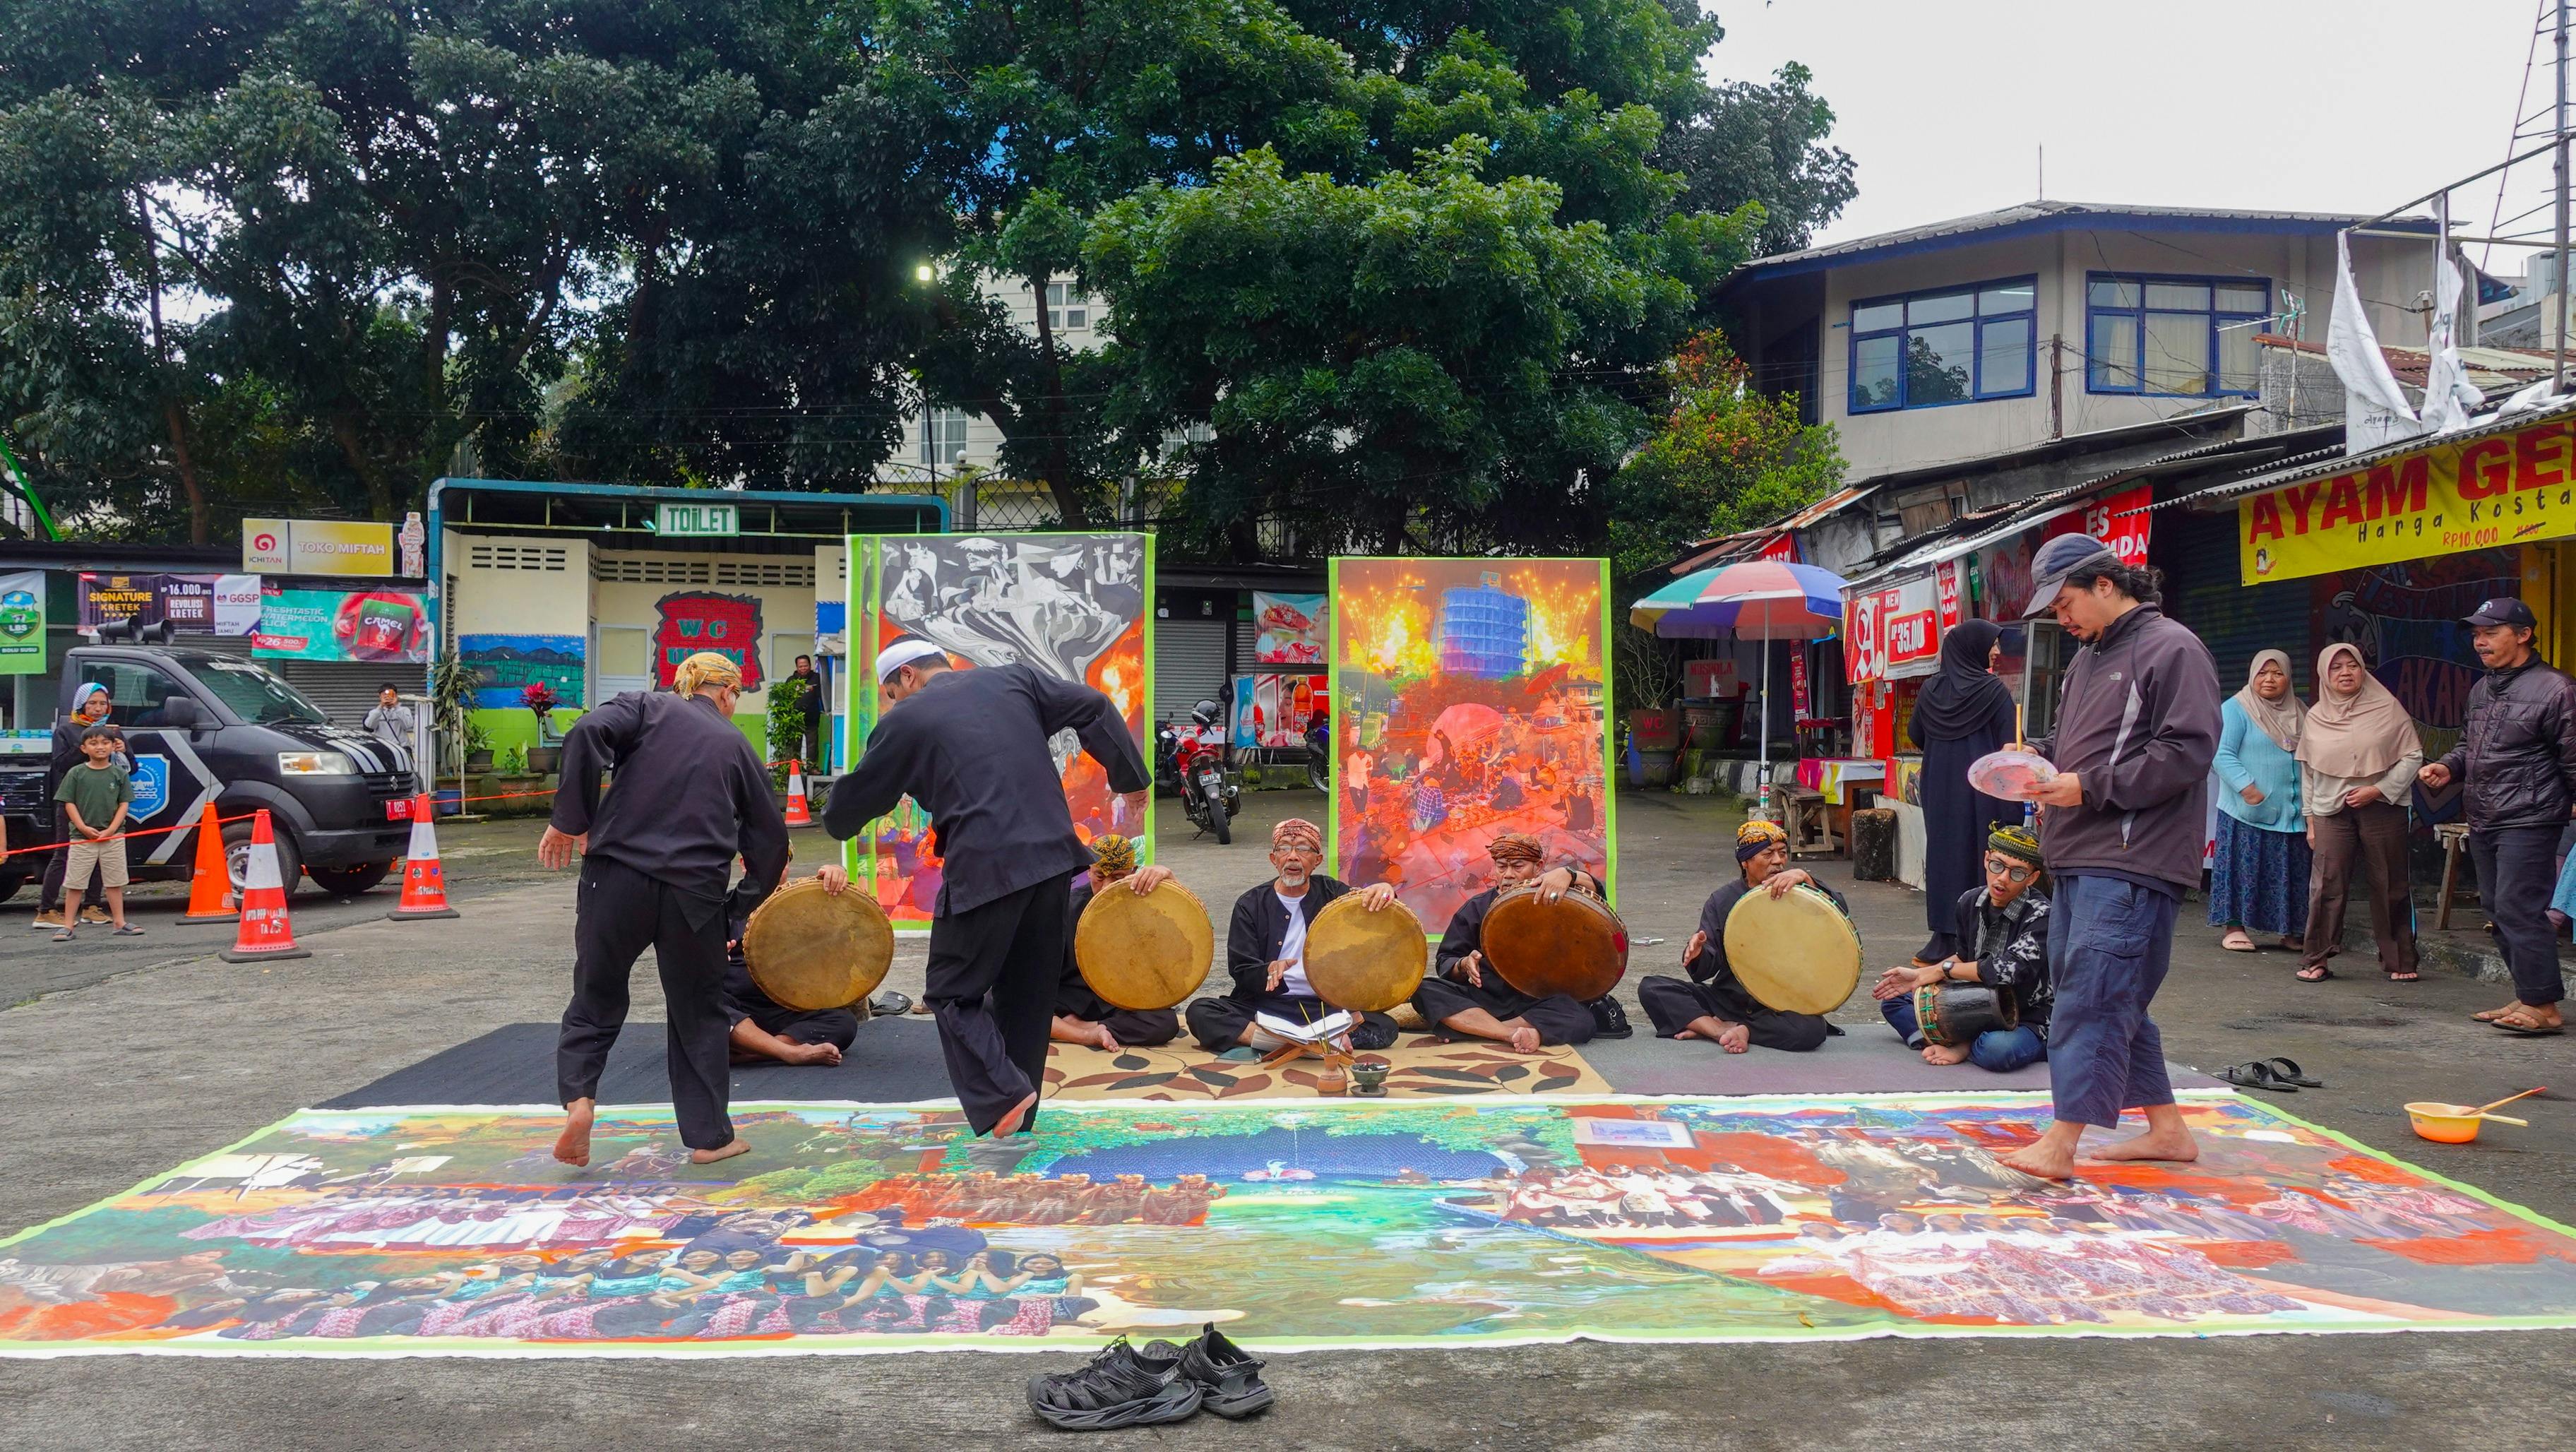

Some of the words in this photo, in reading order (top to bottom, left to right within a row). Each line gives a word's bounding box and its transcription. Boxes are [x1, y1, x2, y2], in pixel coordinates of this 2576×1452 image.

[2249, 456, 2429, 544] AYAM
[2458, 419, 2576, 501] GE
[2359, 513, 2443, 542] Harga
[2471, 489, 2571, 523] Kosta
[2087, 506, 2109, 539] ES
[299, 542, 335, 553] TOKO
[338, 543, 386, 554] MIFTAH
[169, 584, 201, 595] 16.000
[89, 592, 153, 602] SIGNATURE
[229, 594, 259, 603] GGSP
[170, 599, 203, 608] REVOLUSI
[170, 609, 203, 618] KRETEK
[261, 606, 324, 615] FRESHTASTIC
[261, 613, 328, 622] WATERMELON
[364, 617, 402, 631] CAMEL
[1642, 717, 1664, 729] WC
